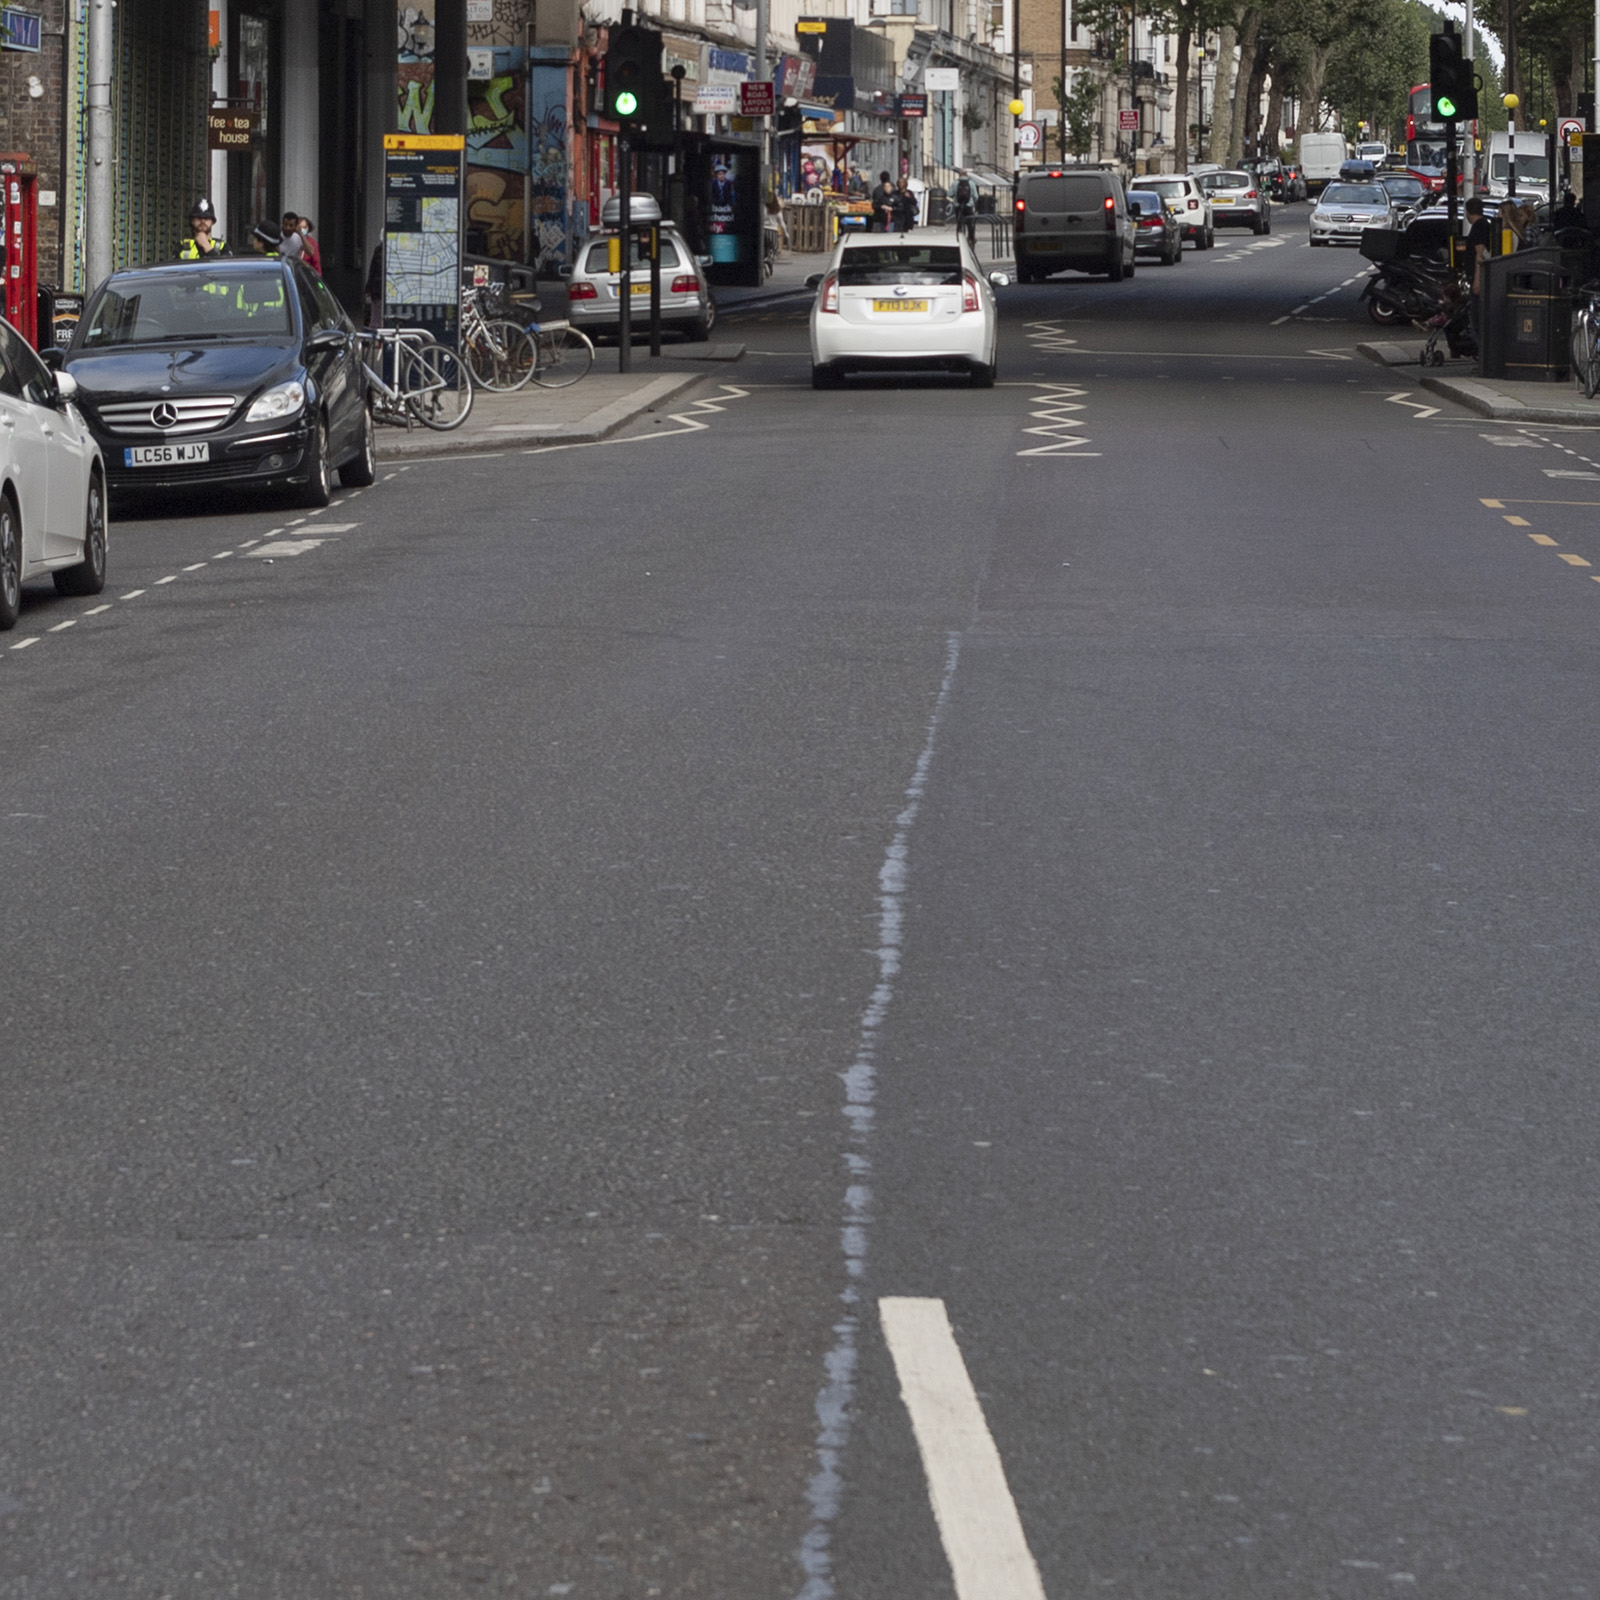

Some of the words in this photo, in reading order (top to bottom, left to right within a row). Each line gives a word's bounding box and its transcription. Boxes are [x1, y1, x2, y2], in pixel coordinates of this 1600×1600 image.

[234, 117, 250, 129] tea
[219, 131, 250, 144] house
[711, 203, 732, 212] back
[133, 446, 172, 464] LC56
[177, 444, 207, 461] WJY
